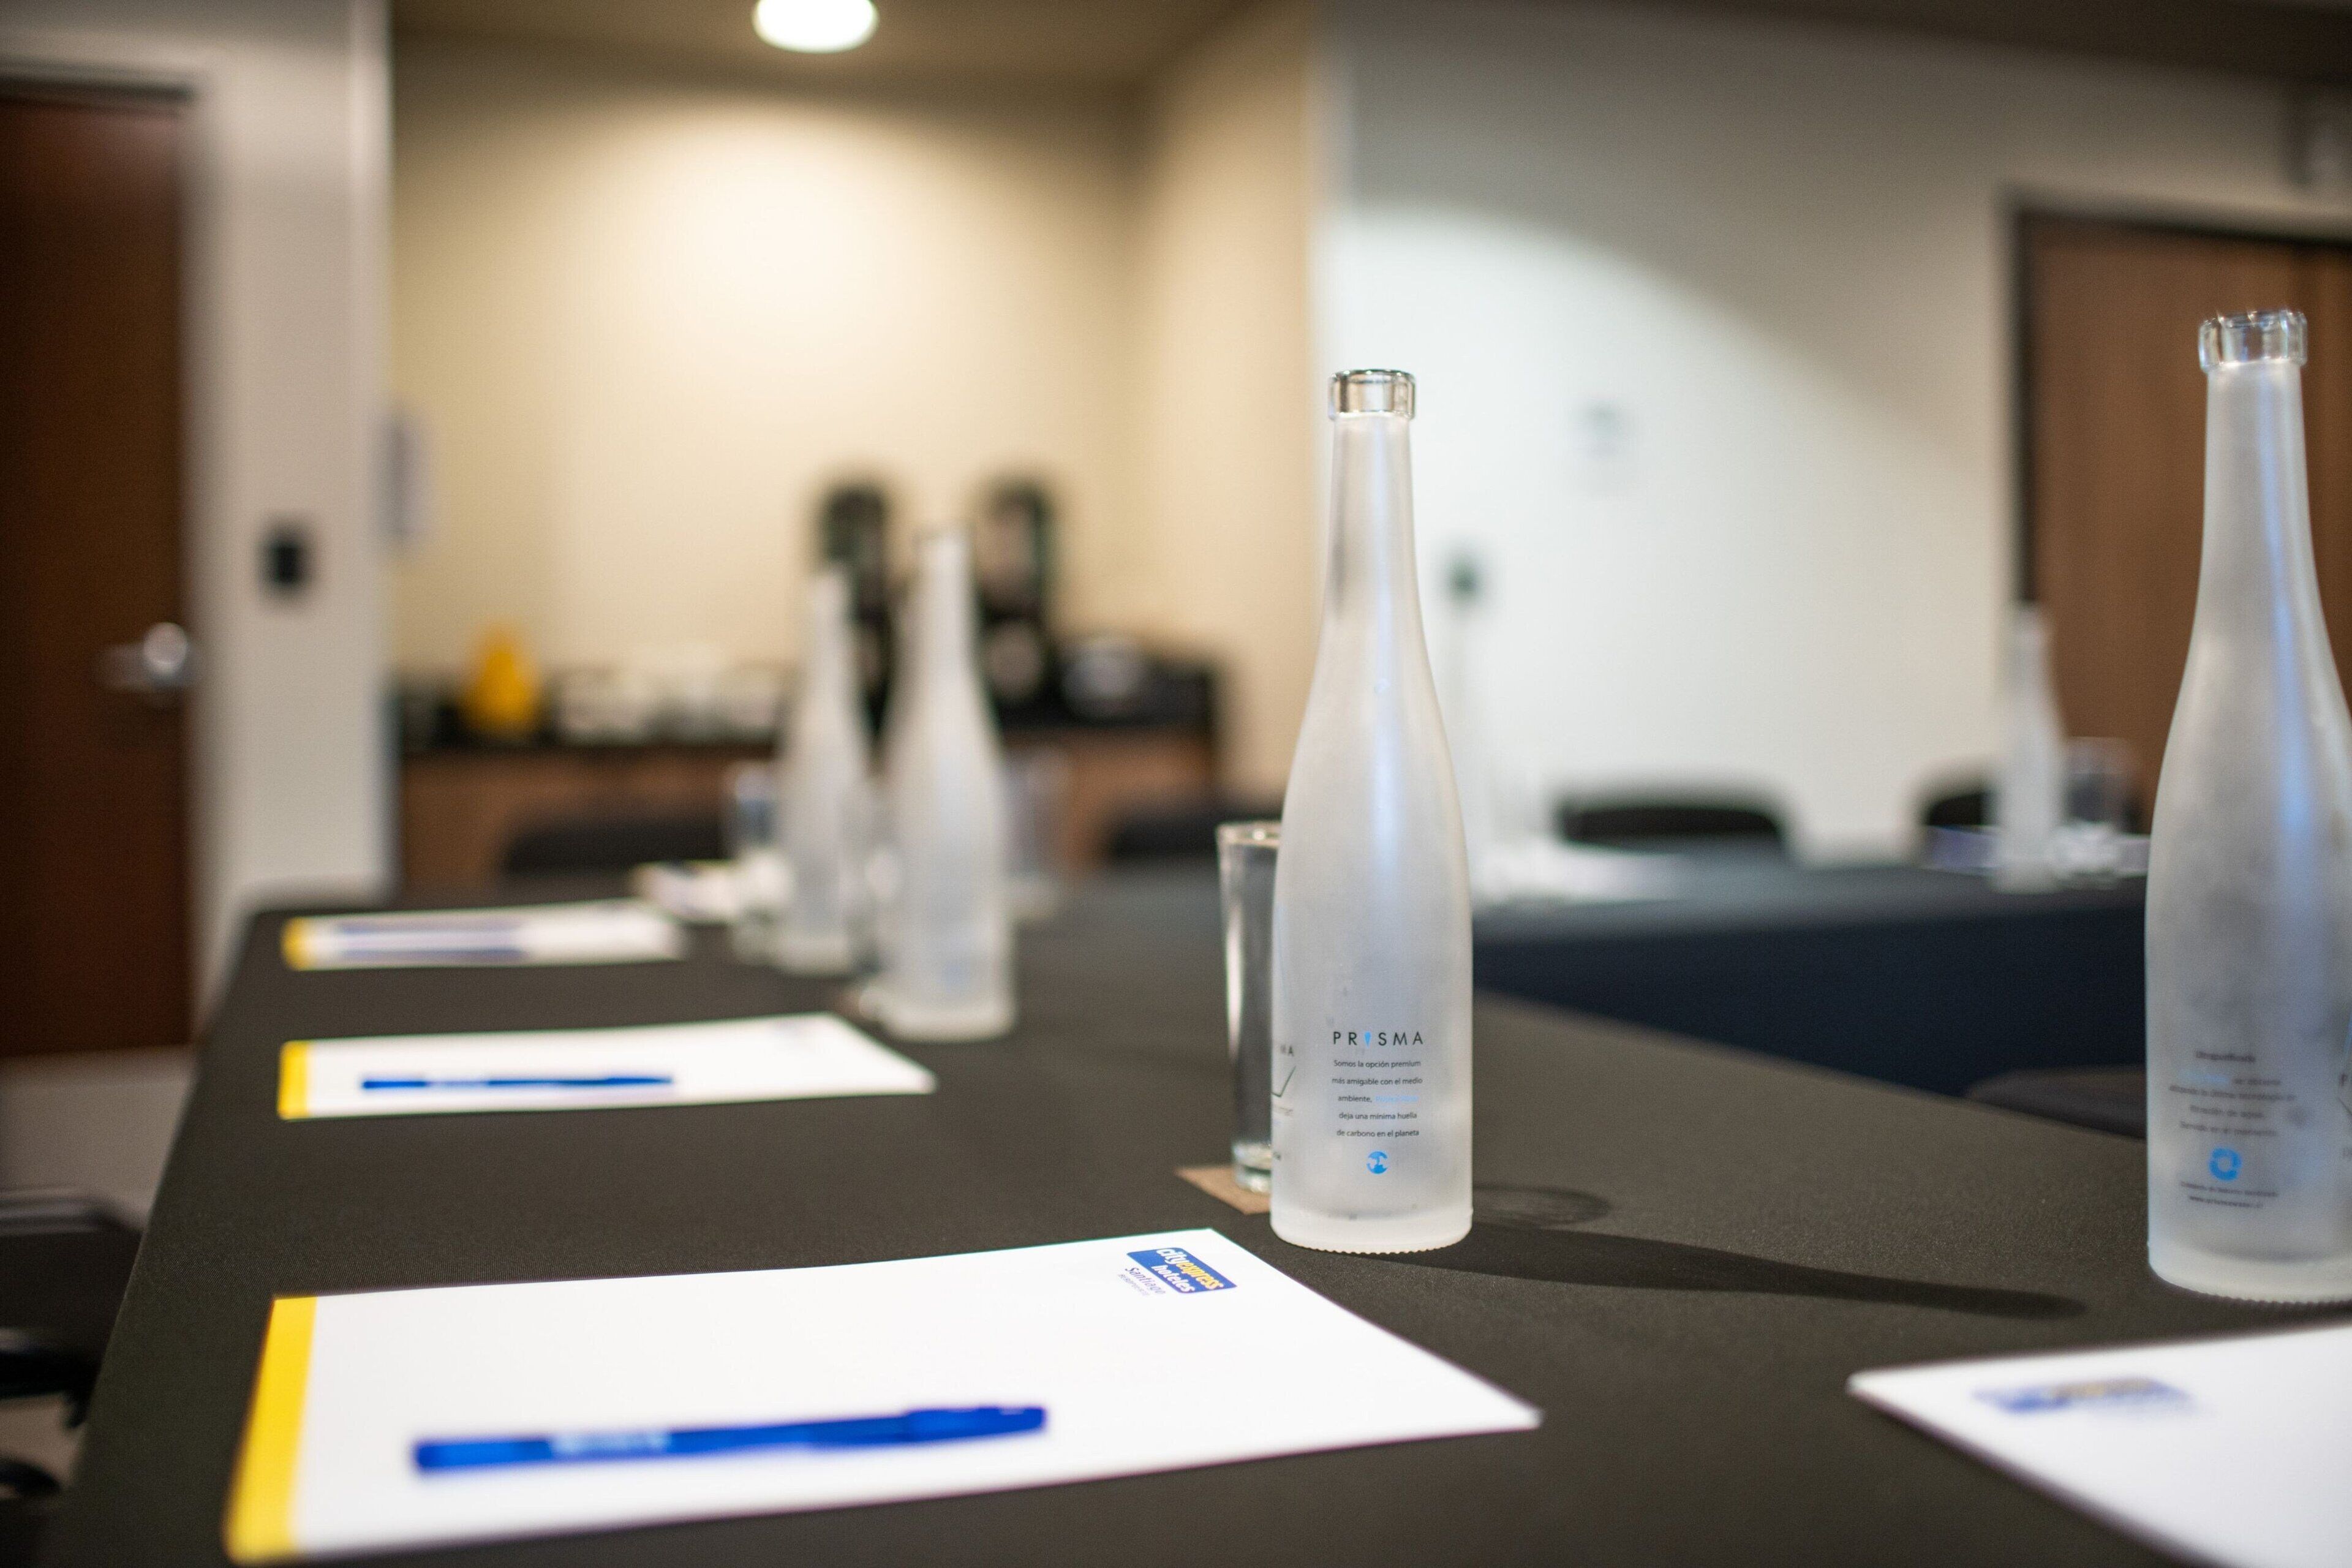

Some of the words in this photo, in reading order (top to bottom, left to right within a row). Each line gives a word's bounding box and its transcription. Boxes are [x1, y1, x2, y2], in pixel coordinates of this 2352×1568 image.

[1333, 1031, 1423, 1049] PRISMA
[1365, 1060, 1389, 1069] opción
[1391, 1060, 1421, 1069] premium
[1347, 1077, 1379, 1086] amigable
[1395, 1129, 1420, 1138] planeta
[1125, 1267, 1166, 1294] Santiago
[1151, 1264, 1196, 1294] hoteles
